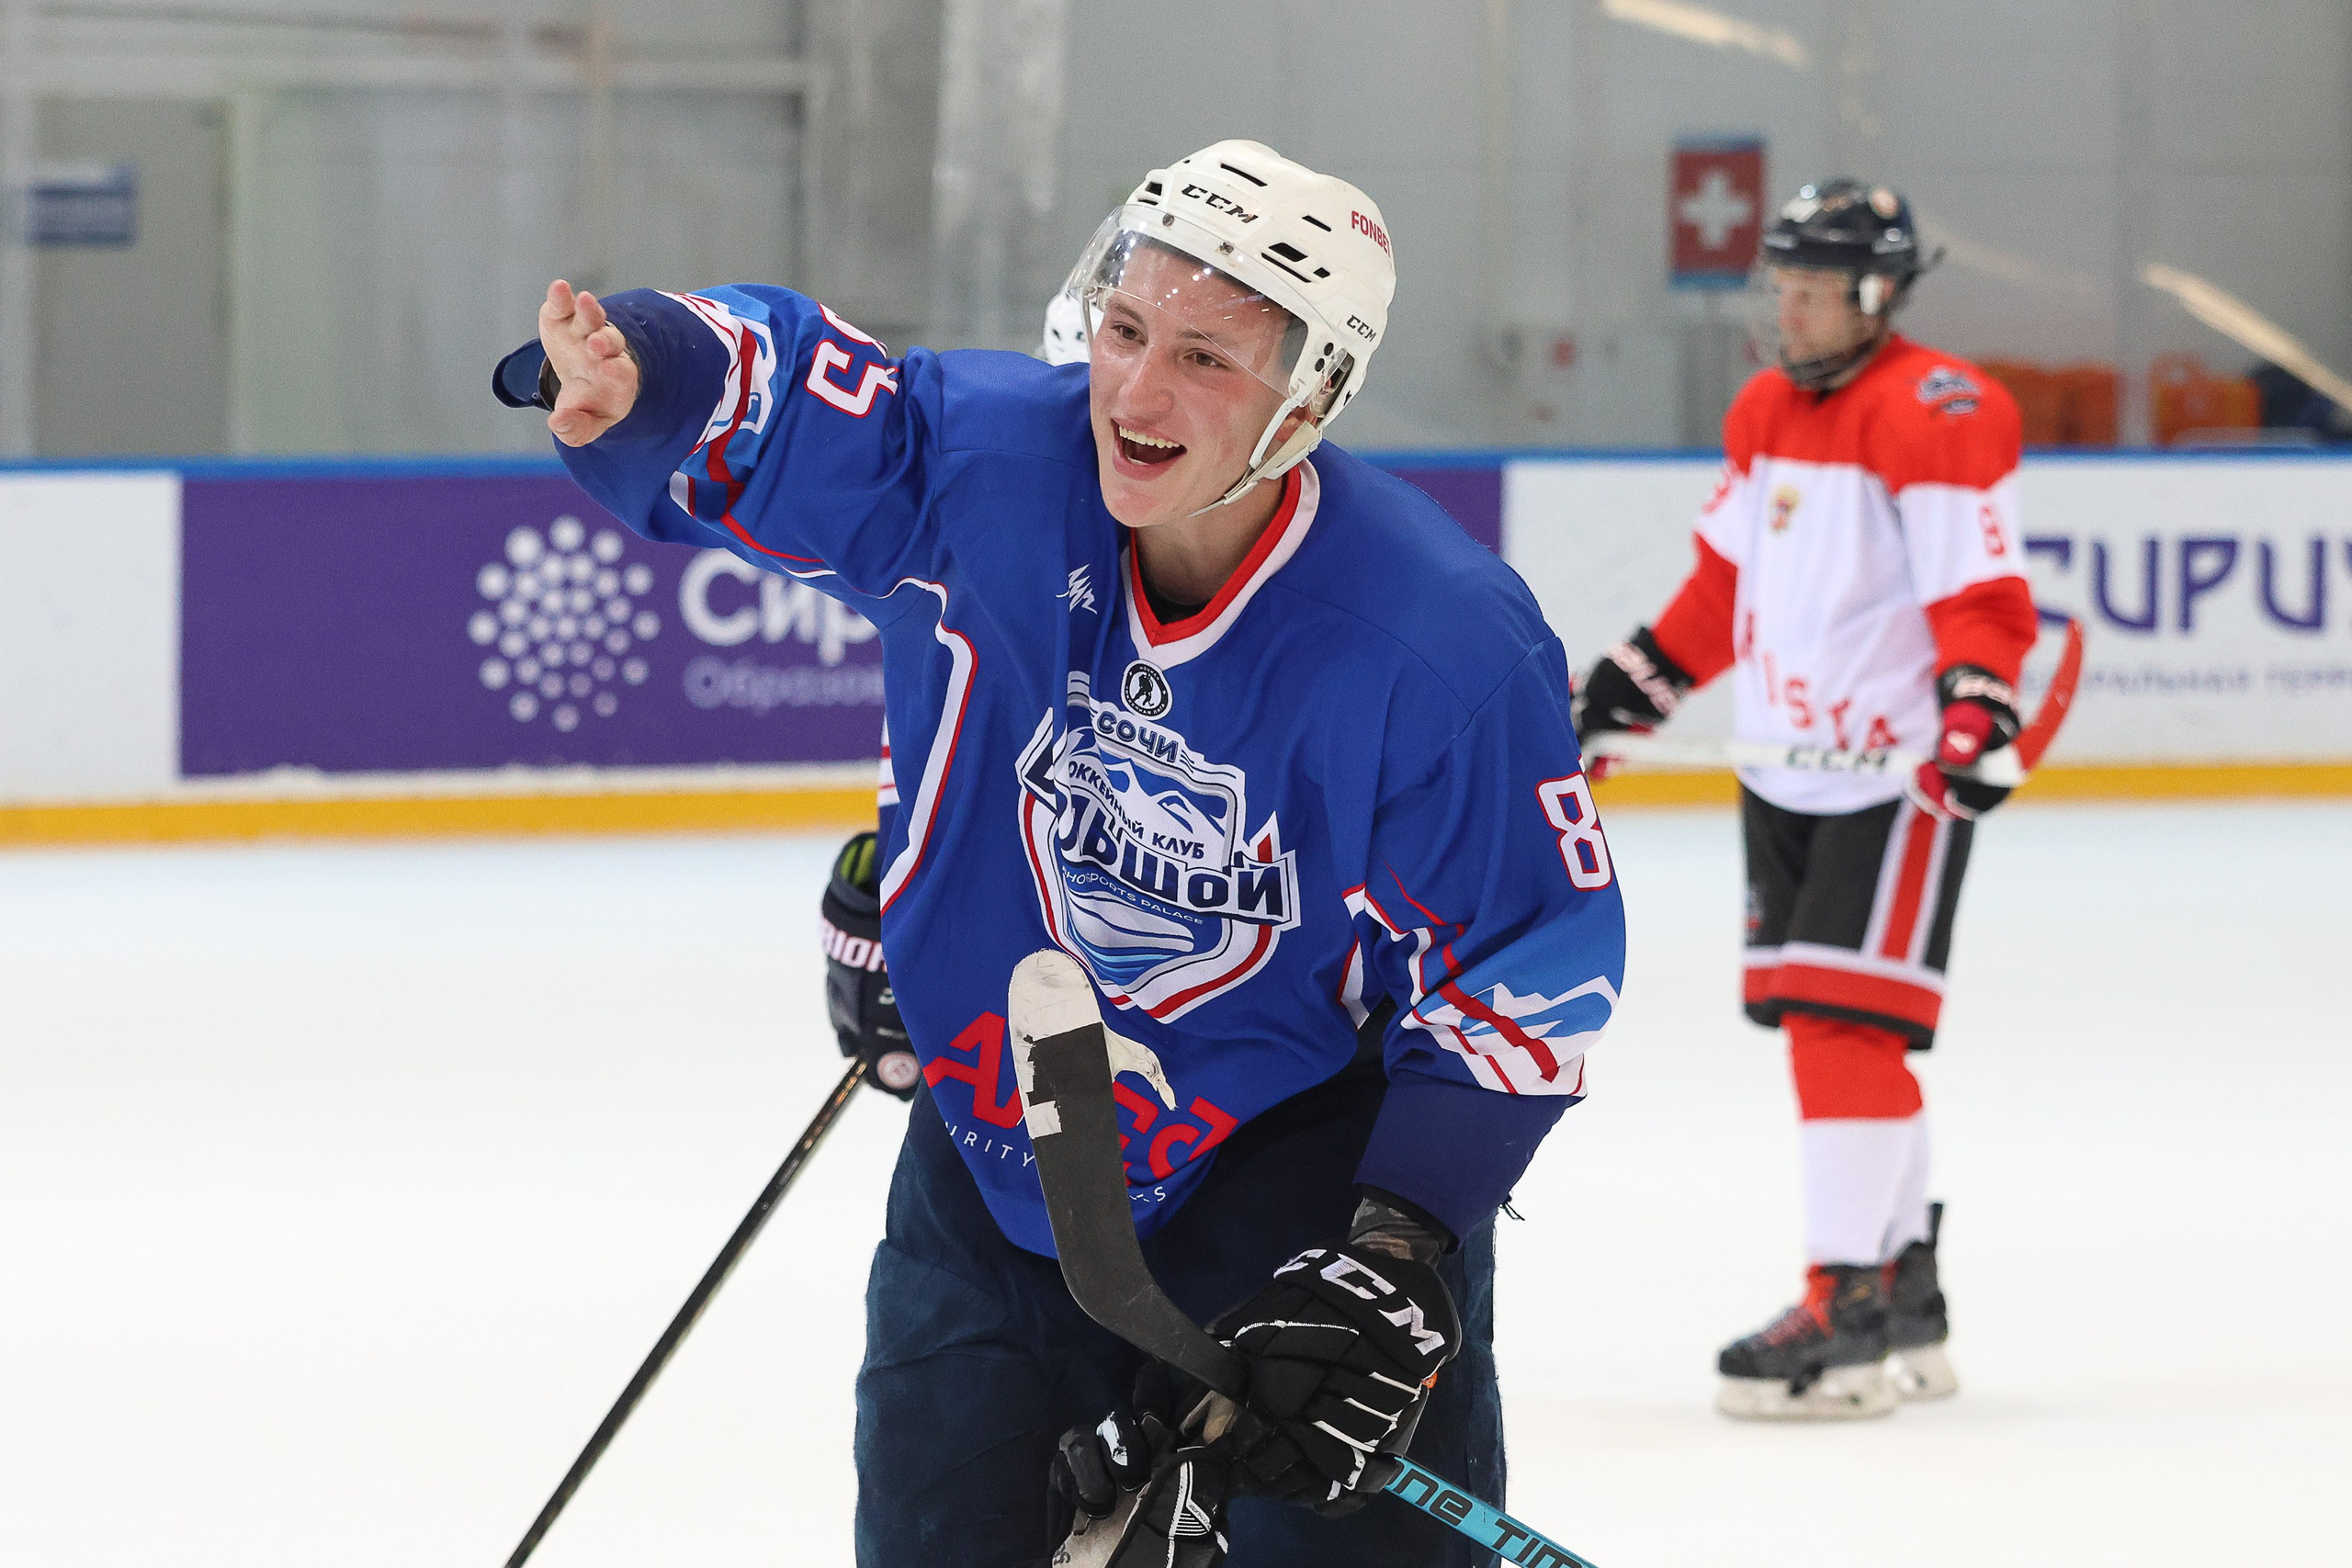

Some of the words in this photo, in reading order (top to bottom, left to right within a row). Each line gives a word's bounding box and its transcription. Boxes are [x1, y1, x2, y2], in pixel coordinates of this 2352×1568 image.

[1182, 184, 1259, 224] CCM
[1346, 314, 1377, 344] CCM
[1097, 711, 1179, 763] СОЧИ
[1069, 761, 1145, 840] ОККЕЙНЫЙ
[1152, 832, 1205, 860] КЛУБ
[1535, 770, 1612, 892] 8
[1141, 898, 1204, 925] PALACE
[944, 1121, 1036, 1168] URITY
[1273, 1248, 1446, 1356] CCM
